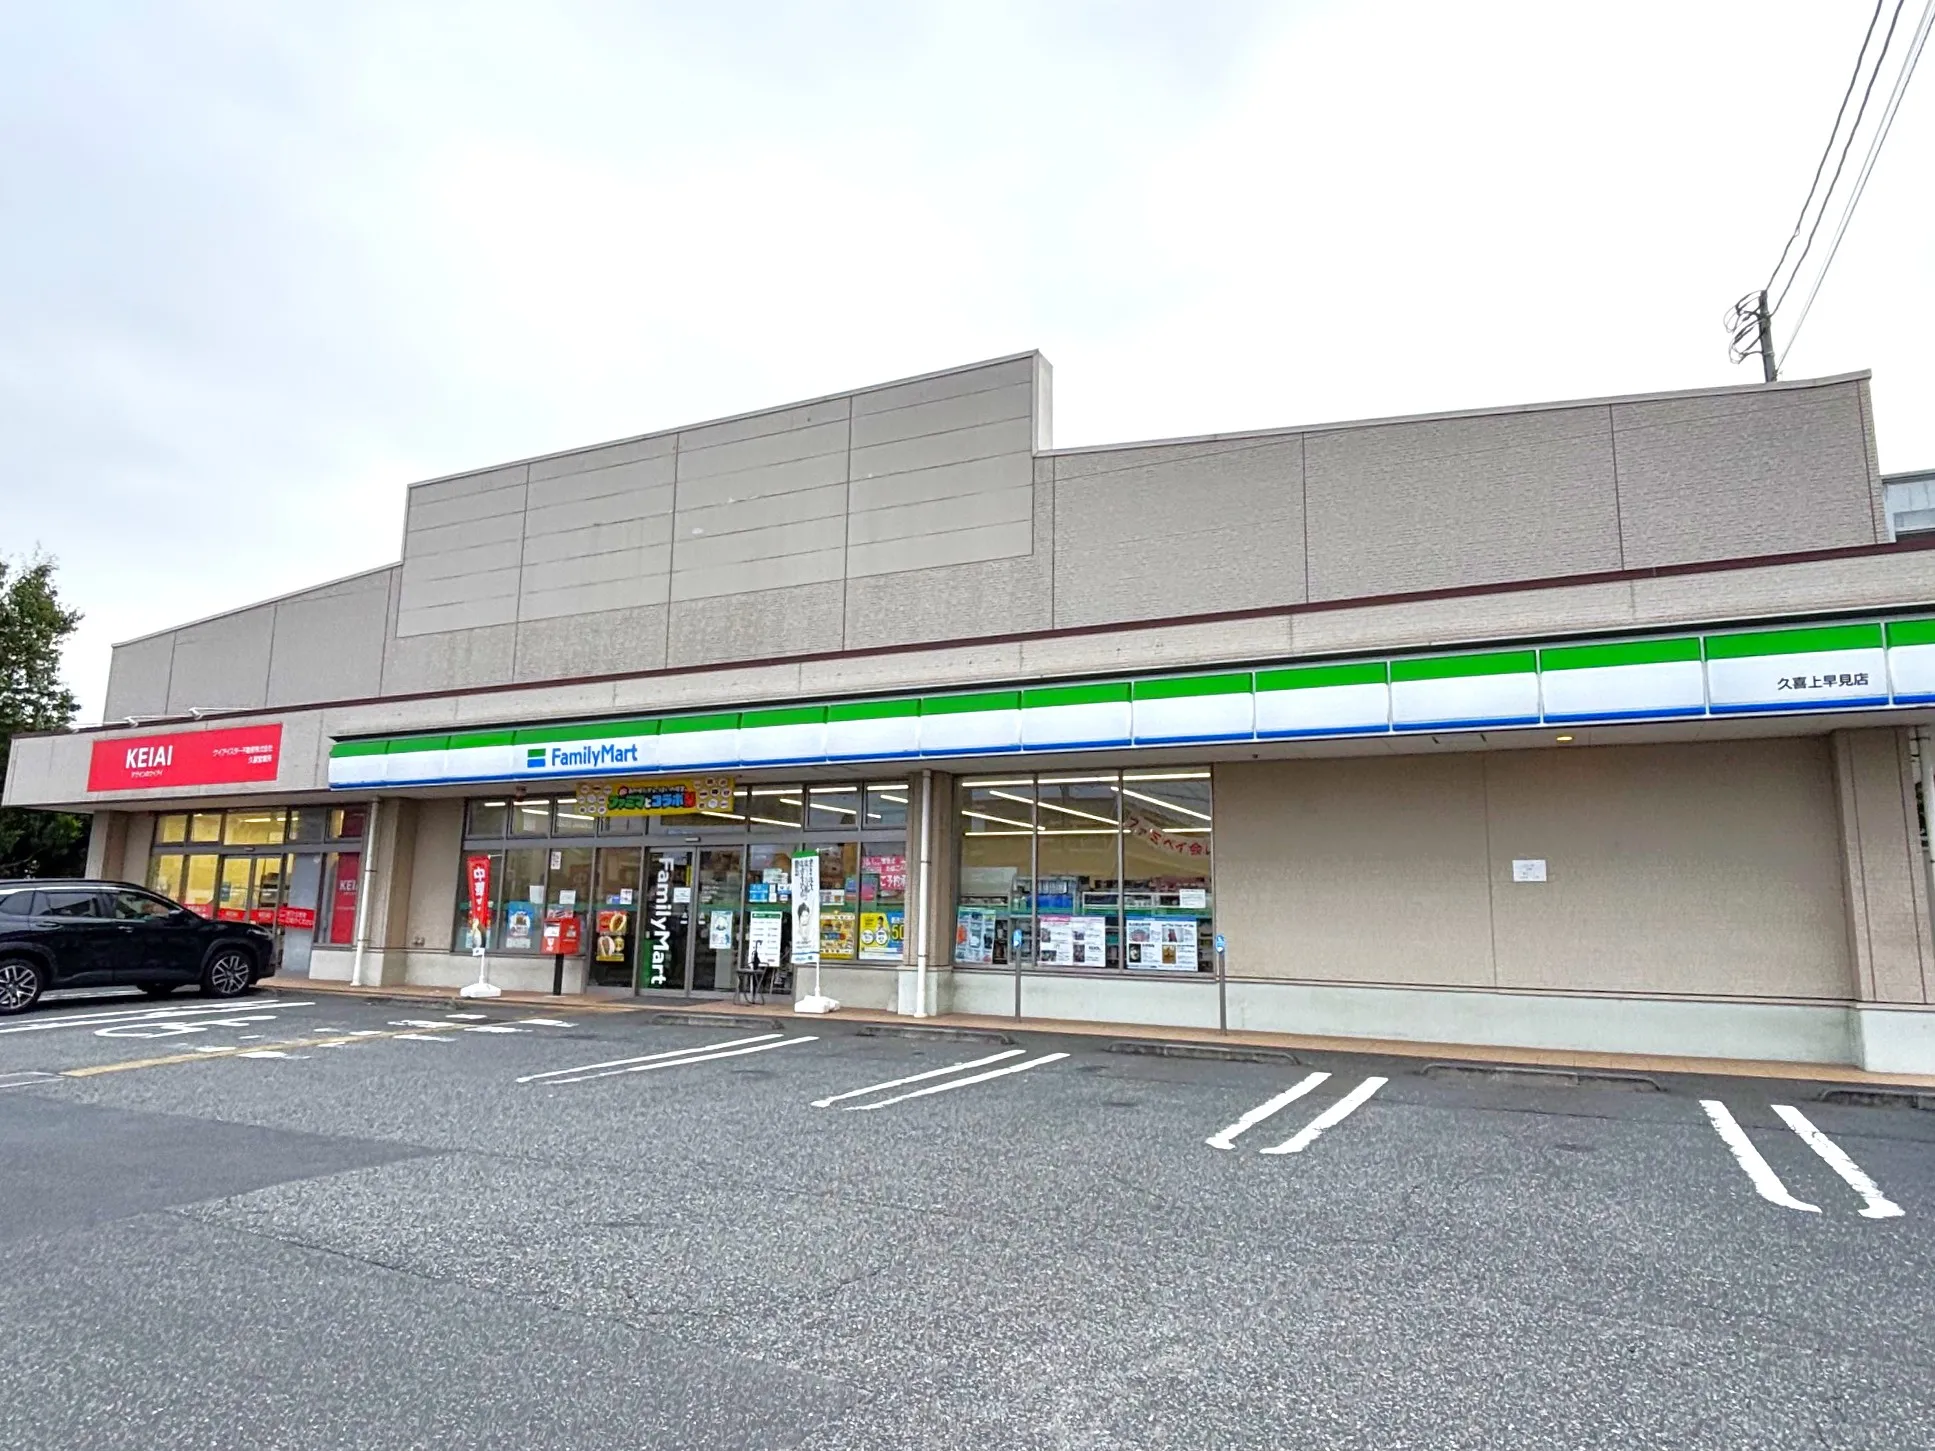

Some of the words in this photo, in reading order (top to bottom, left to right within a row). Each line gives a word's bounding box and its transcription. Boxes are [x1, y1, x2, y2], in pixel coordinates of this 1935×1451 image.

[1777, 673, 1869, 690] 久喜上早見店
[125, 745, 174, 769] KEIAI
[551, 744, 638, 766] FamilyMart
[339, 879, 357, 892] KEI
[650, 858, 674, 985] FamilyMart
